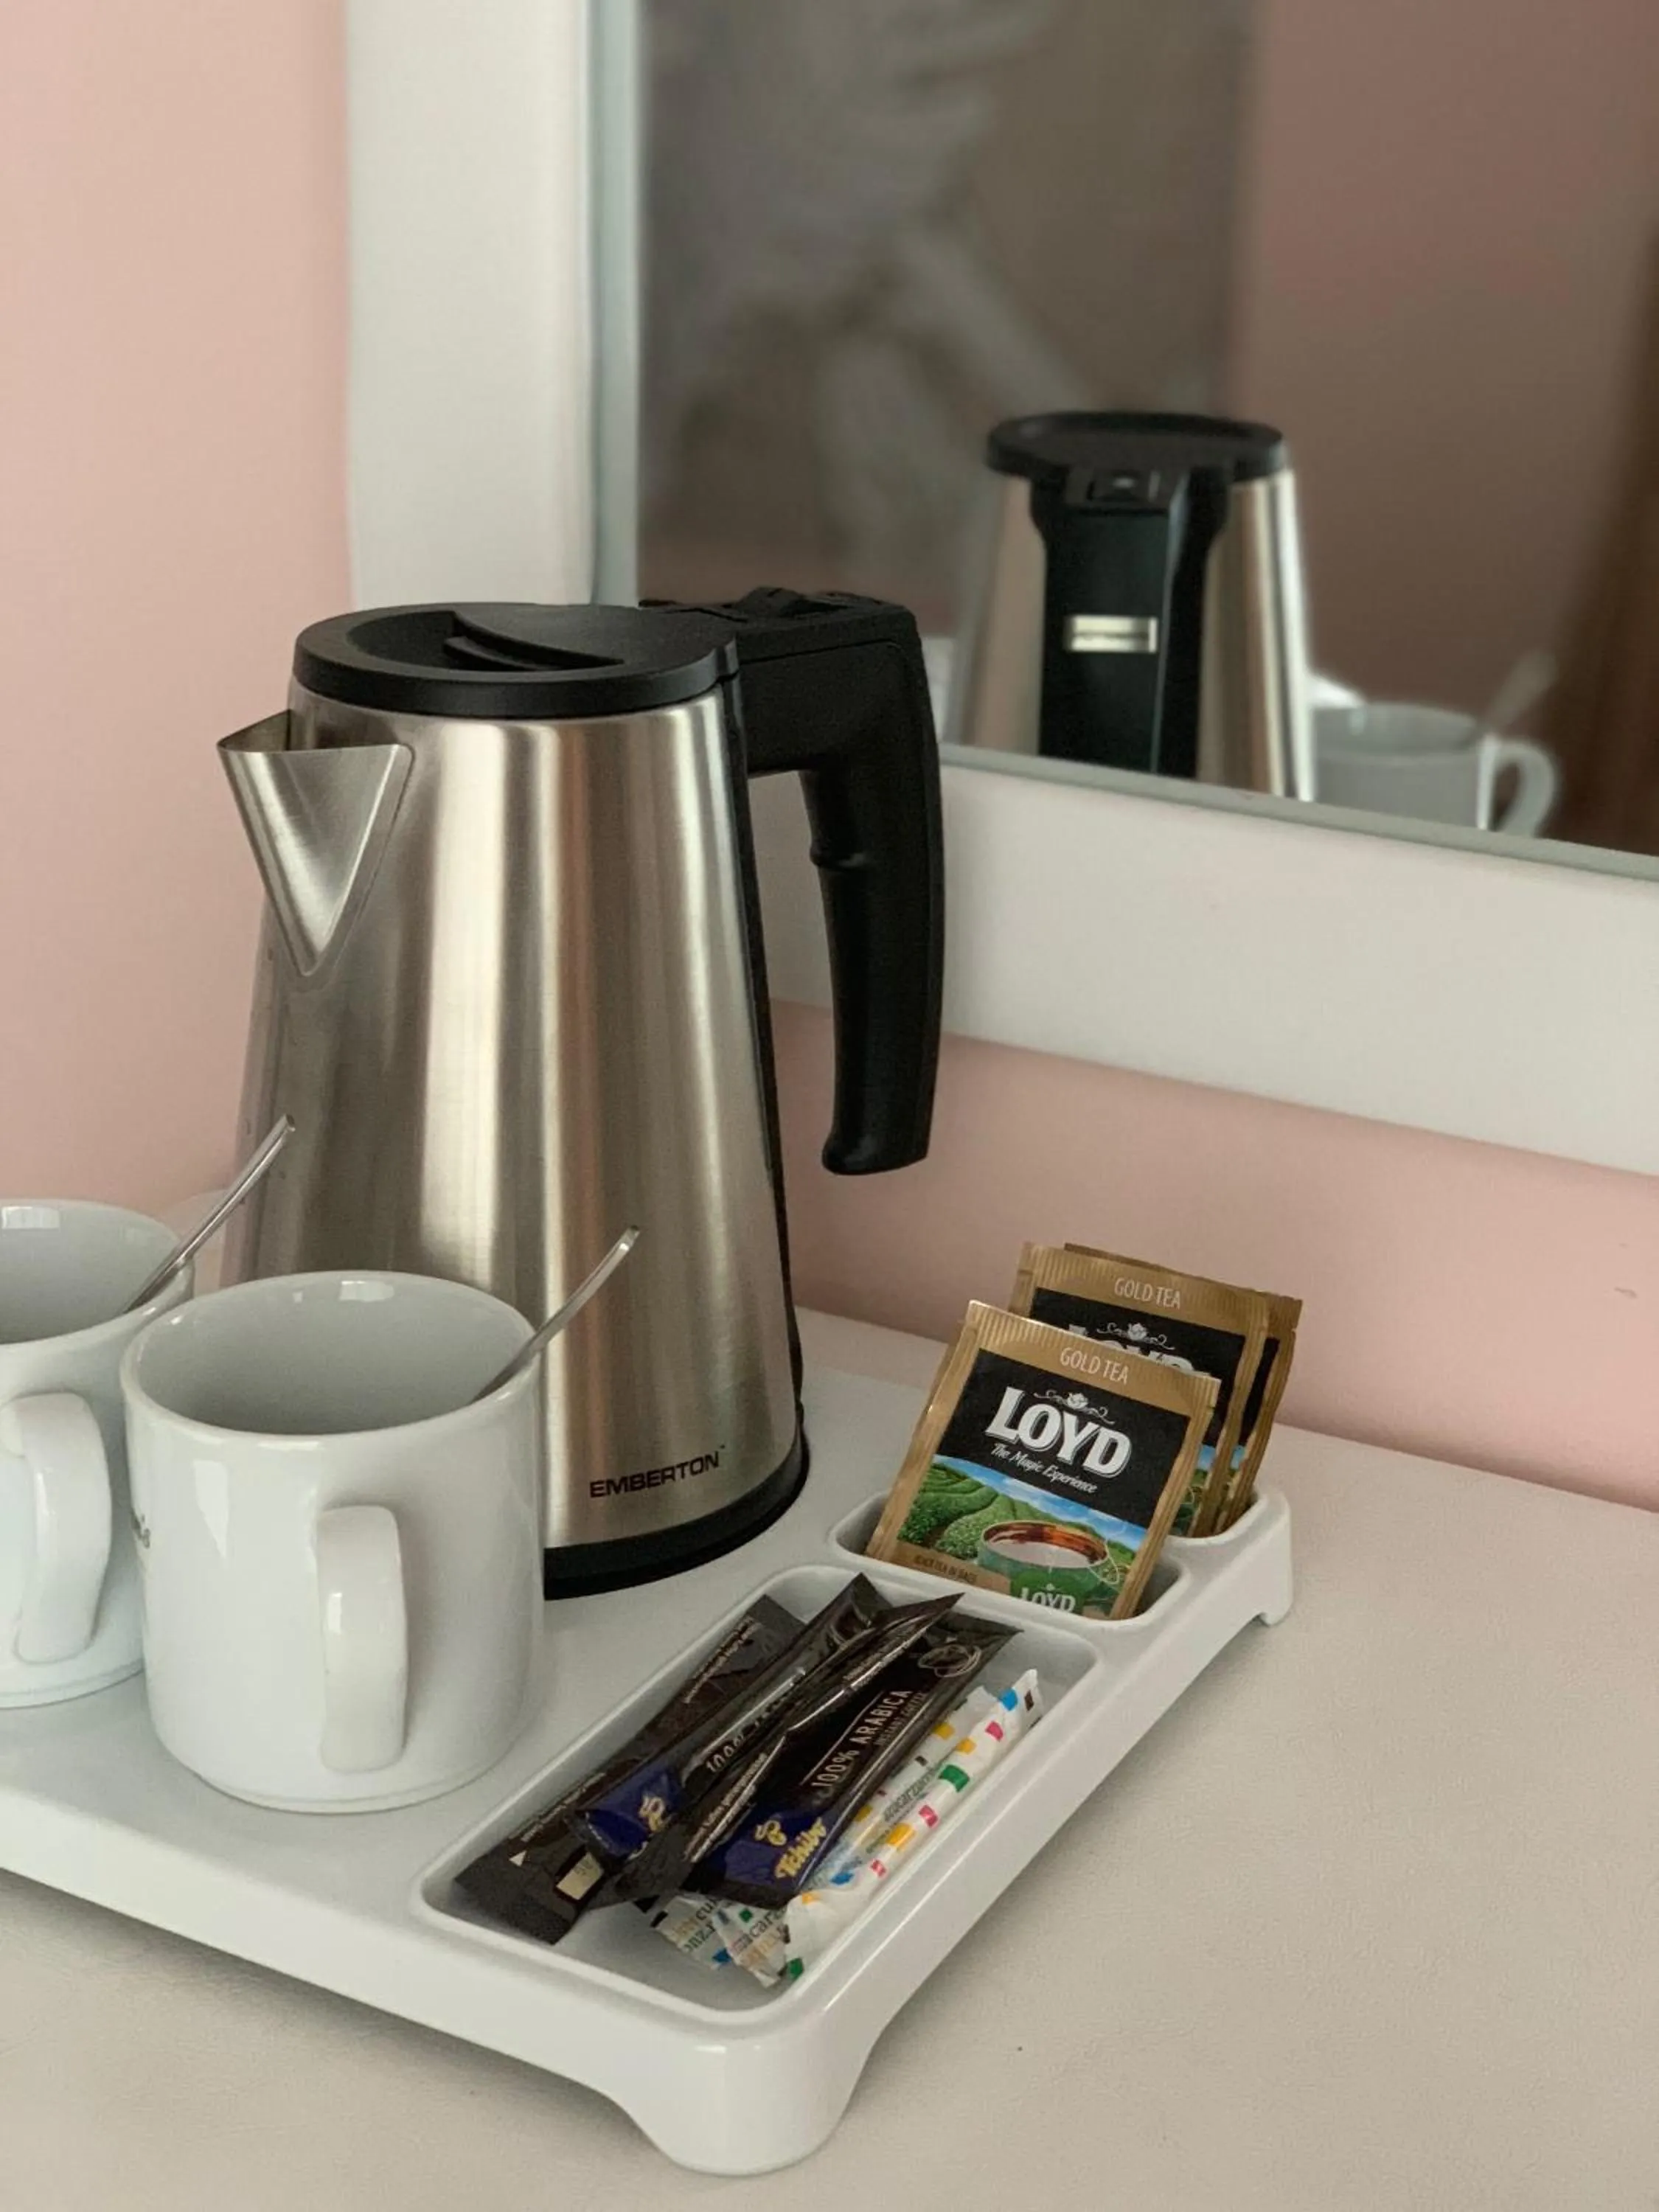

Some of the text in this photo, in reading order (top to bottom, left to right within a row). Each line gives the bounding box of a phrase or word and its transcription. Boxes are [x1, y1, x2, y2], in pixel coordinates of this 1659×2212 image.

[1114, 1277, 1181, 1310] GOLD TEA
[1060, 1346, 1101, 1374] GOLD
[1102, 1359, 1130, 1385] TEA
[985, 1385, 1133, 1479] LOYD
[589, 1450, 720, 1498] EMBERTON
[990, 1442, 1098, 1494] The Magic Experience
[812, 1750, 860, 1787] 100%
[849, 1691, 914, 1745] ARABICA
[775, 1817, 827, 1878] Tchibo
